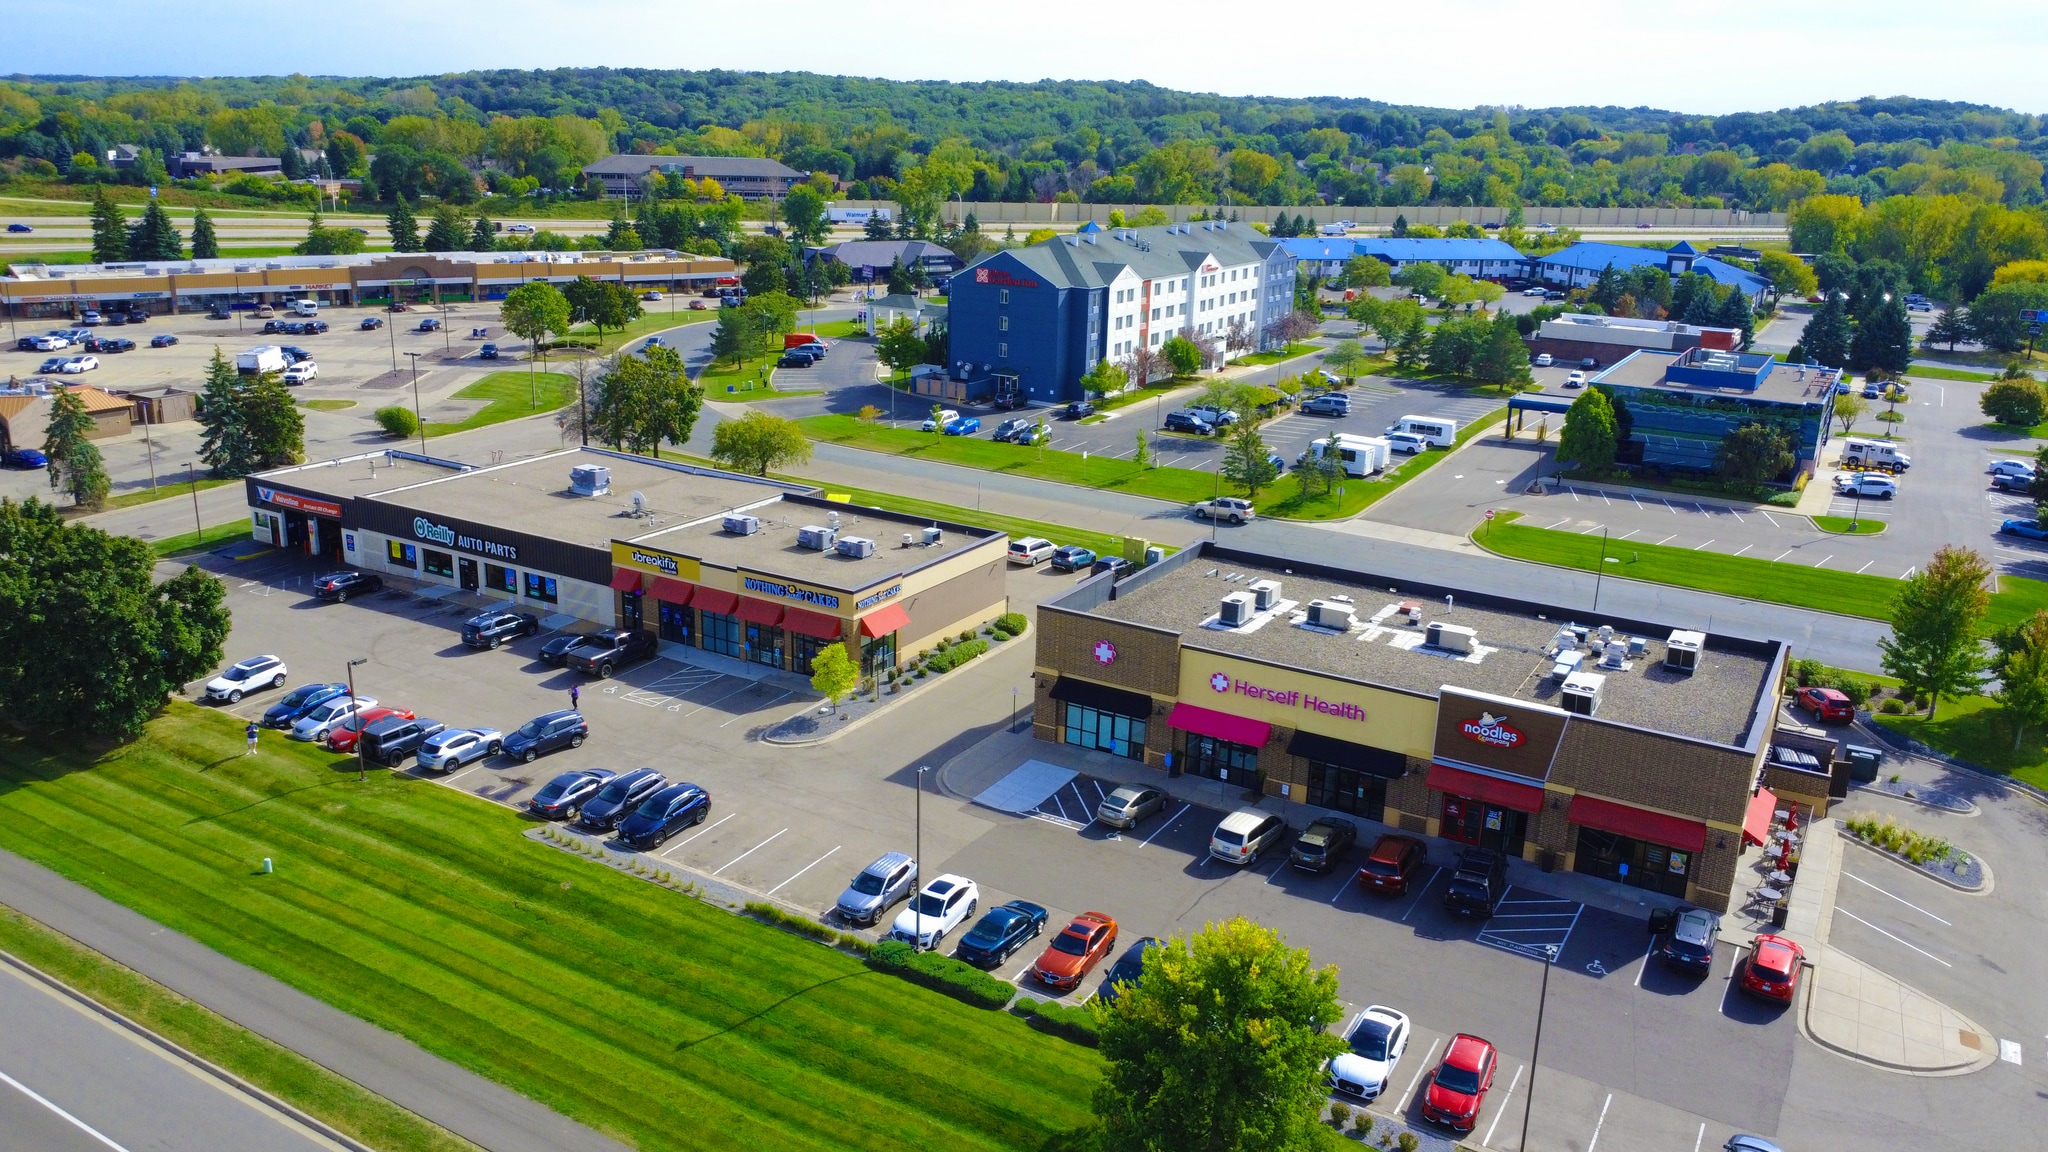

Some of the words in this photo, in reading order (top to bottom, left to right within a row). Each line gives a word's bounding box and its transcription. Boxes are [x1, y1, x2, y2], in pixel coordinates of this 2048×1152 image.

[275, 495, 299, 507] Valvoline
[414, 517, 455, 547] O'Reilly
[458, 535, 483, 552] AUTO
[485, 541, 517, 560] PARTS
[631, 551, 677, 570] ubreakifix
[744, 577, 786, 597] NOTHING
[804, 591, 838, 609] CAKES
[1234, 679, 1299, 707] Herself
[1303, 694, 1366, 722] Health
[1464, 723, 1517, 742] noodles
[1482, 736, 1510, 747] company
